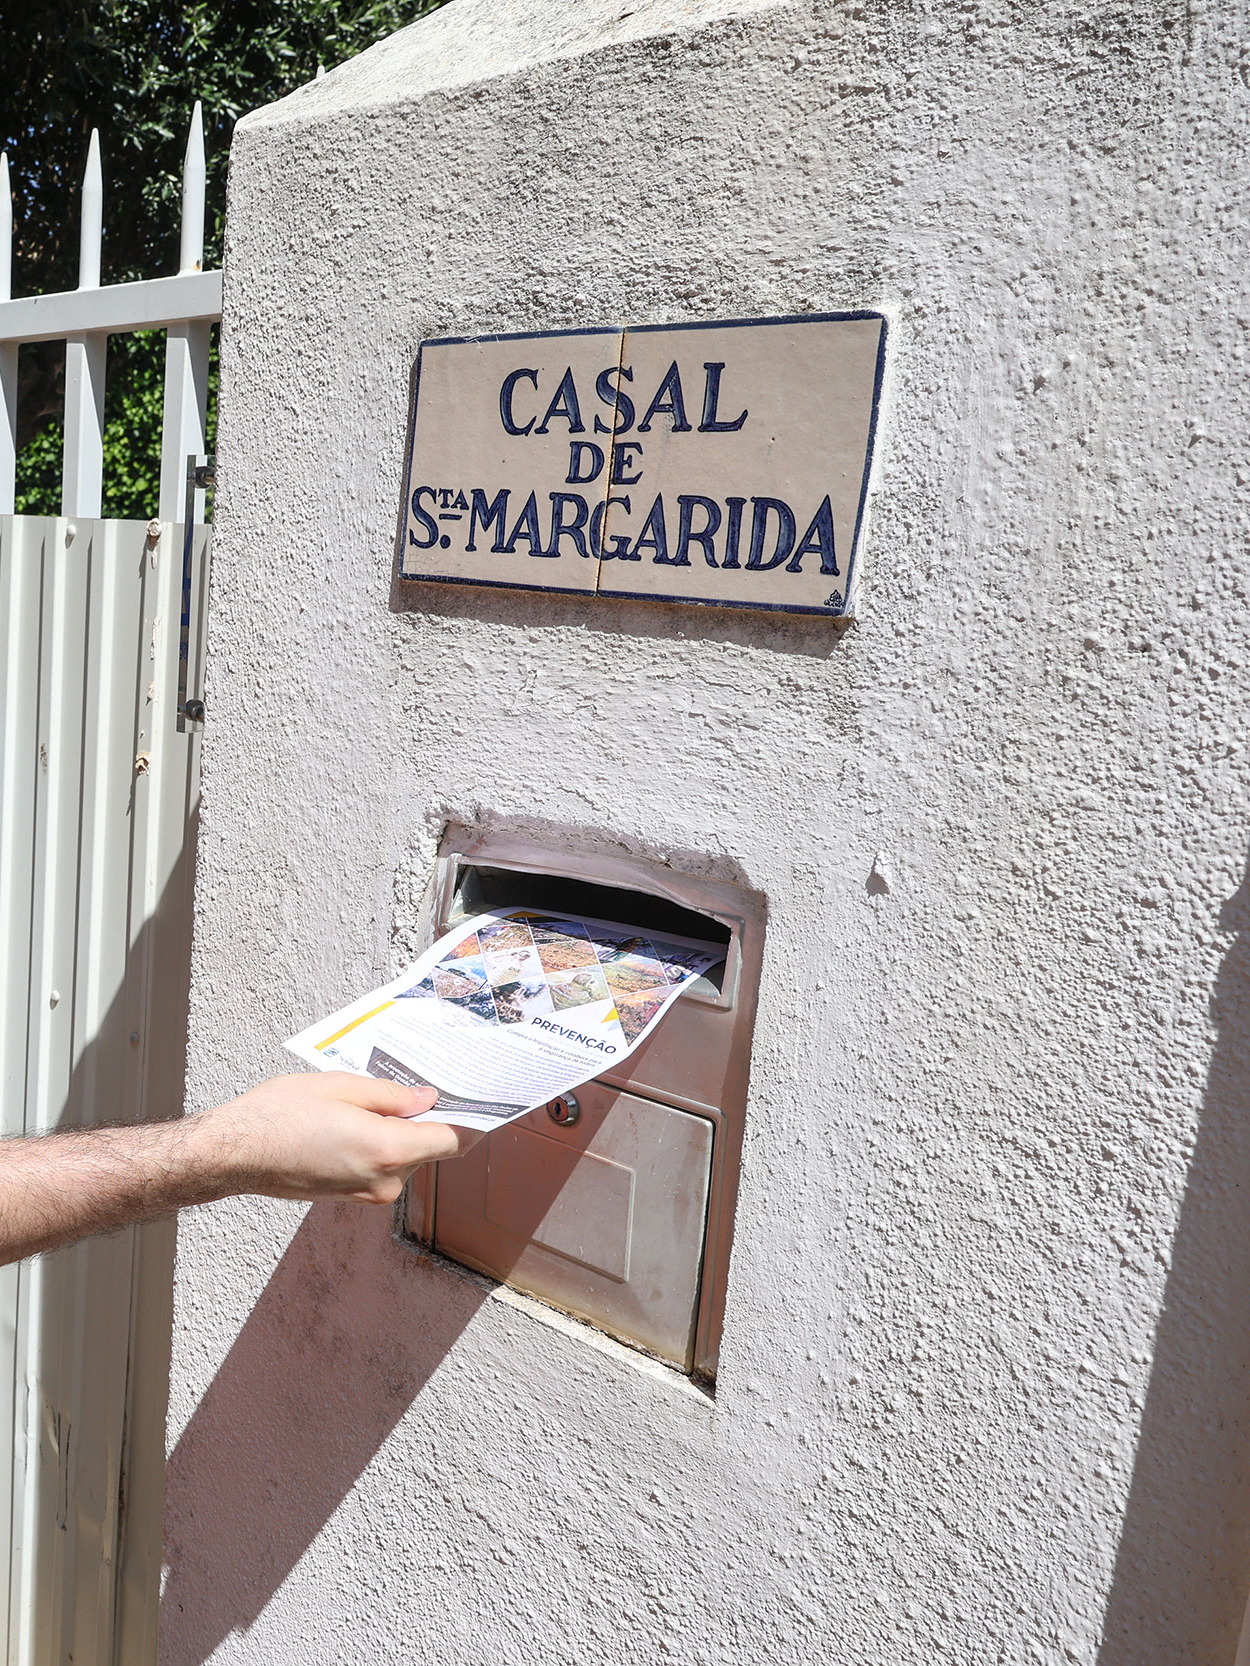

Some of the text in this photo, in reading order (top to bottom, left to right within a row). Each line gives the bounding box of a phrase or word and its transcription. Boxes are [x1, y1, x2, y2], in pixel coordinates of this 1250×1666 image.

[499, 360, 748, 437] CASAL
[565, 441, 644, 486] DE
[465, 488, 840, 577] MARGARIDA
[531, 1017, 617, 1054] PREVENÇÃO
